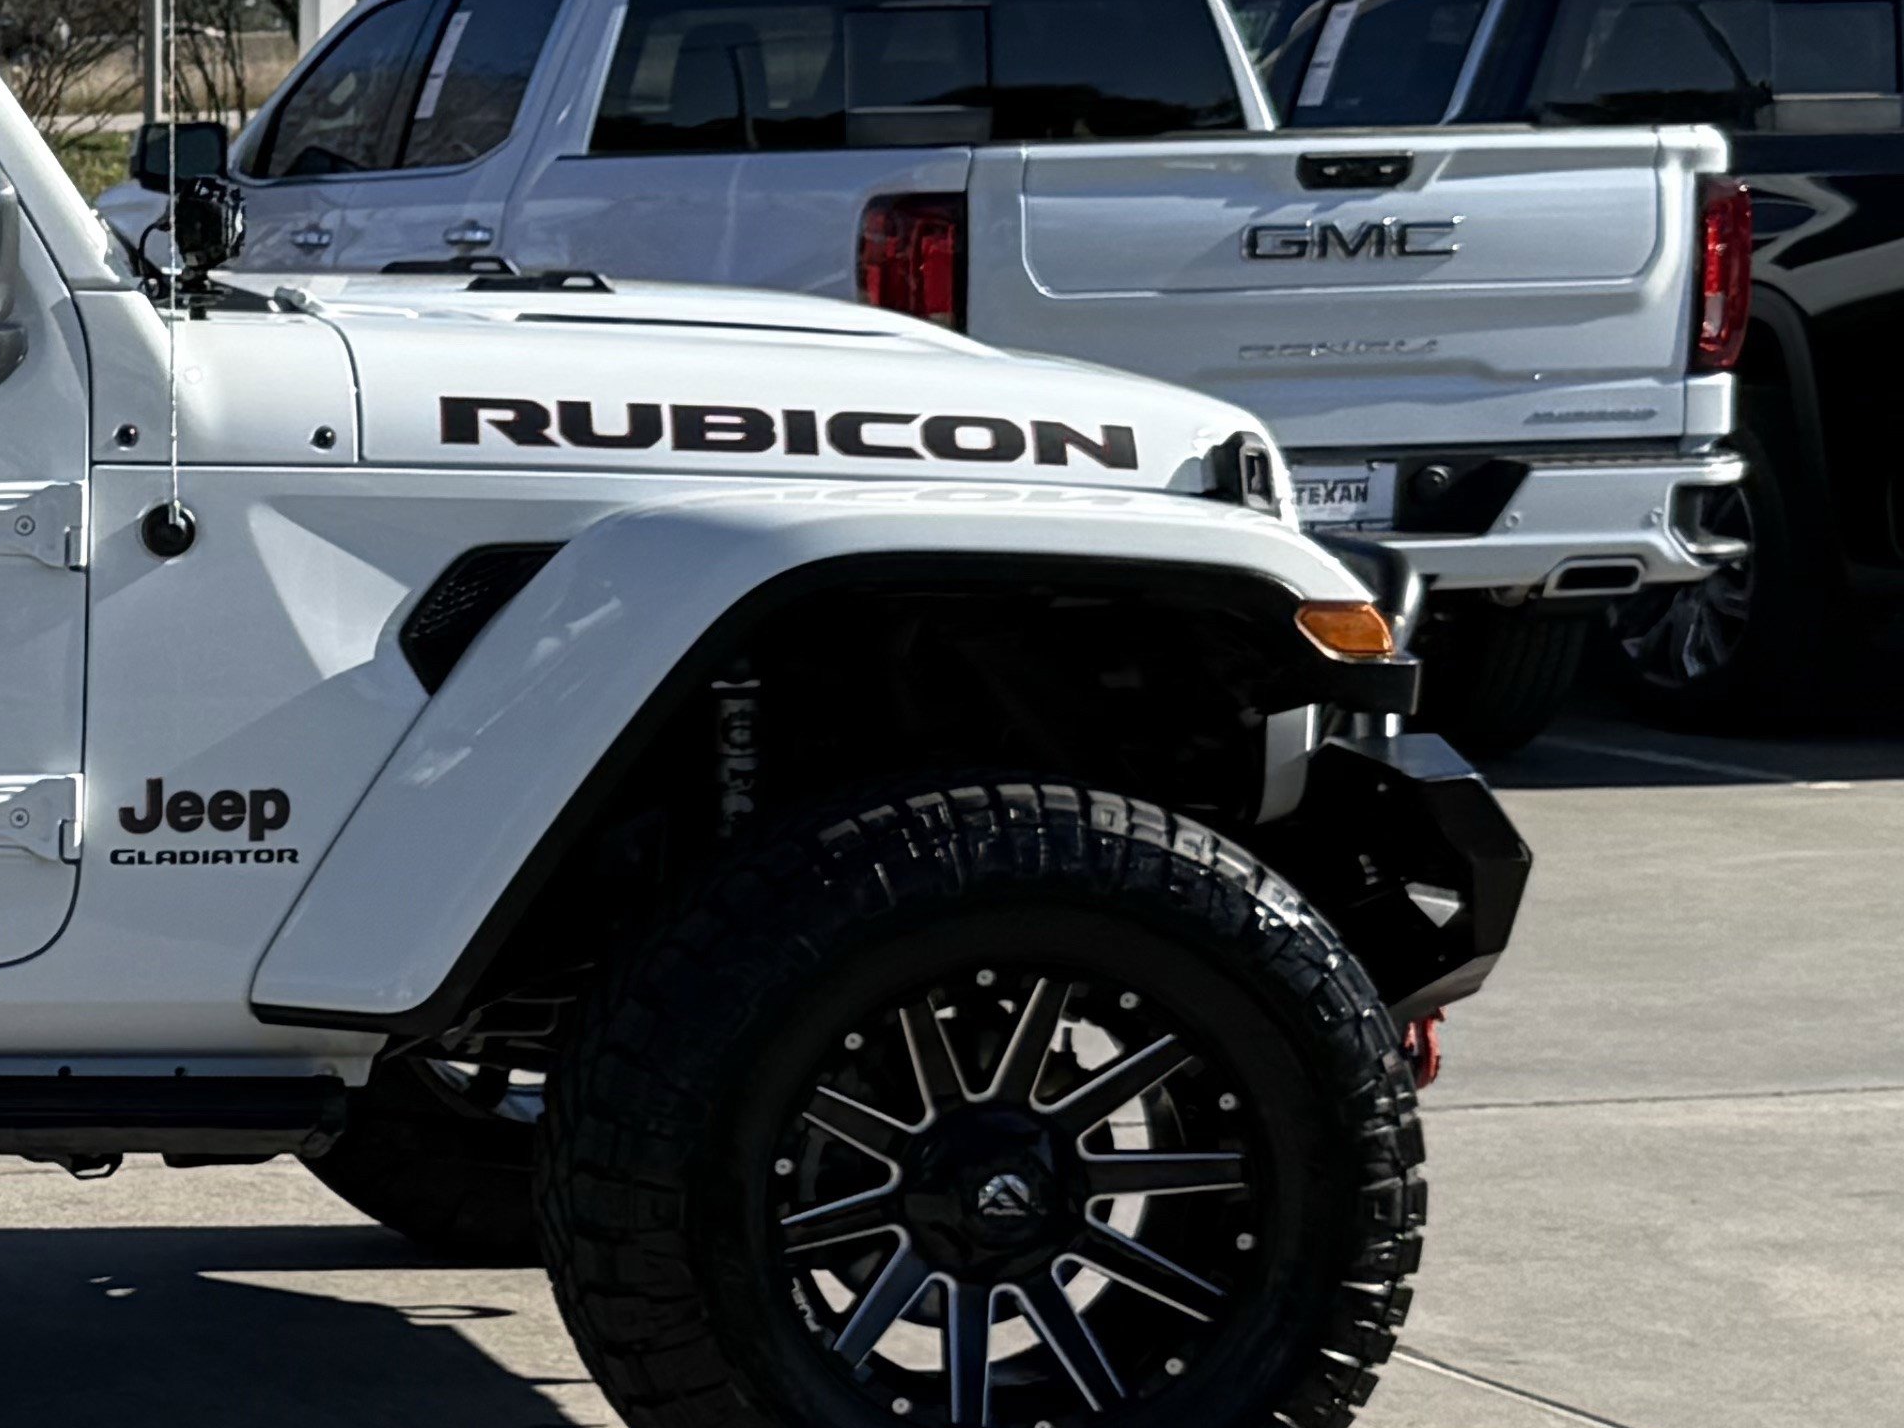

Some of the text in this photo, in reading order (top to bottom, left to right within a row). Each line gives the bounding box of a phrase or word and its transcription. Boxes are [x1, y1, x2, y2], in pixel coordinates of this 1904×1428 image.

[1241, 217, 1463, 259] GMC
[439, 395, 1139, 470] RUBICON
[1294, 481, 1369, 506] TEXAN
[118, 777, 290, 842] Jeep
[109, 848, 300, 866] GLADIATOR
